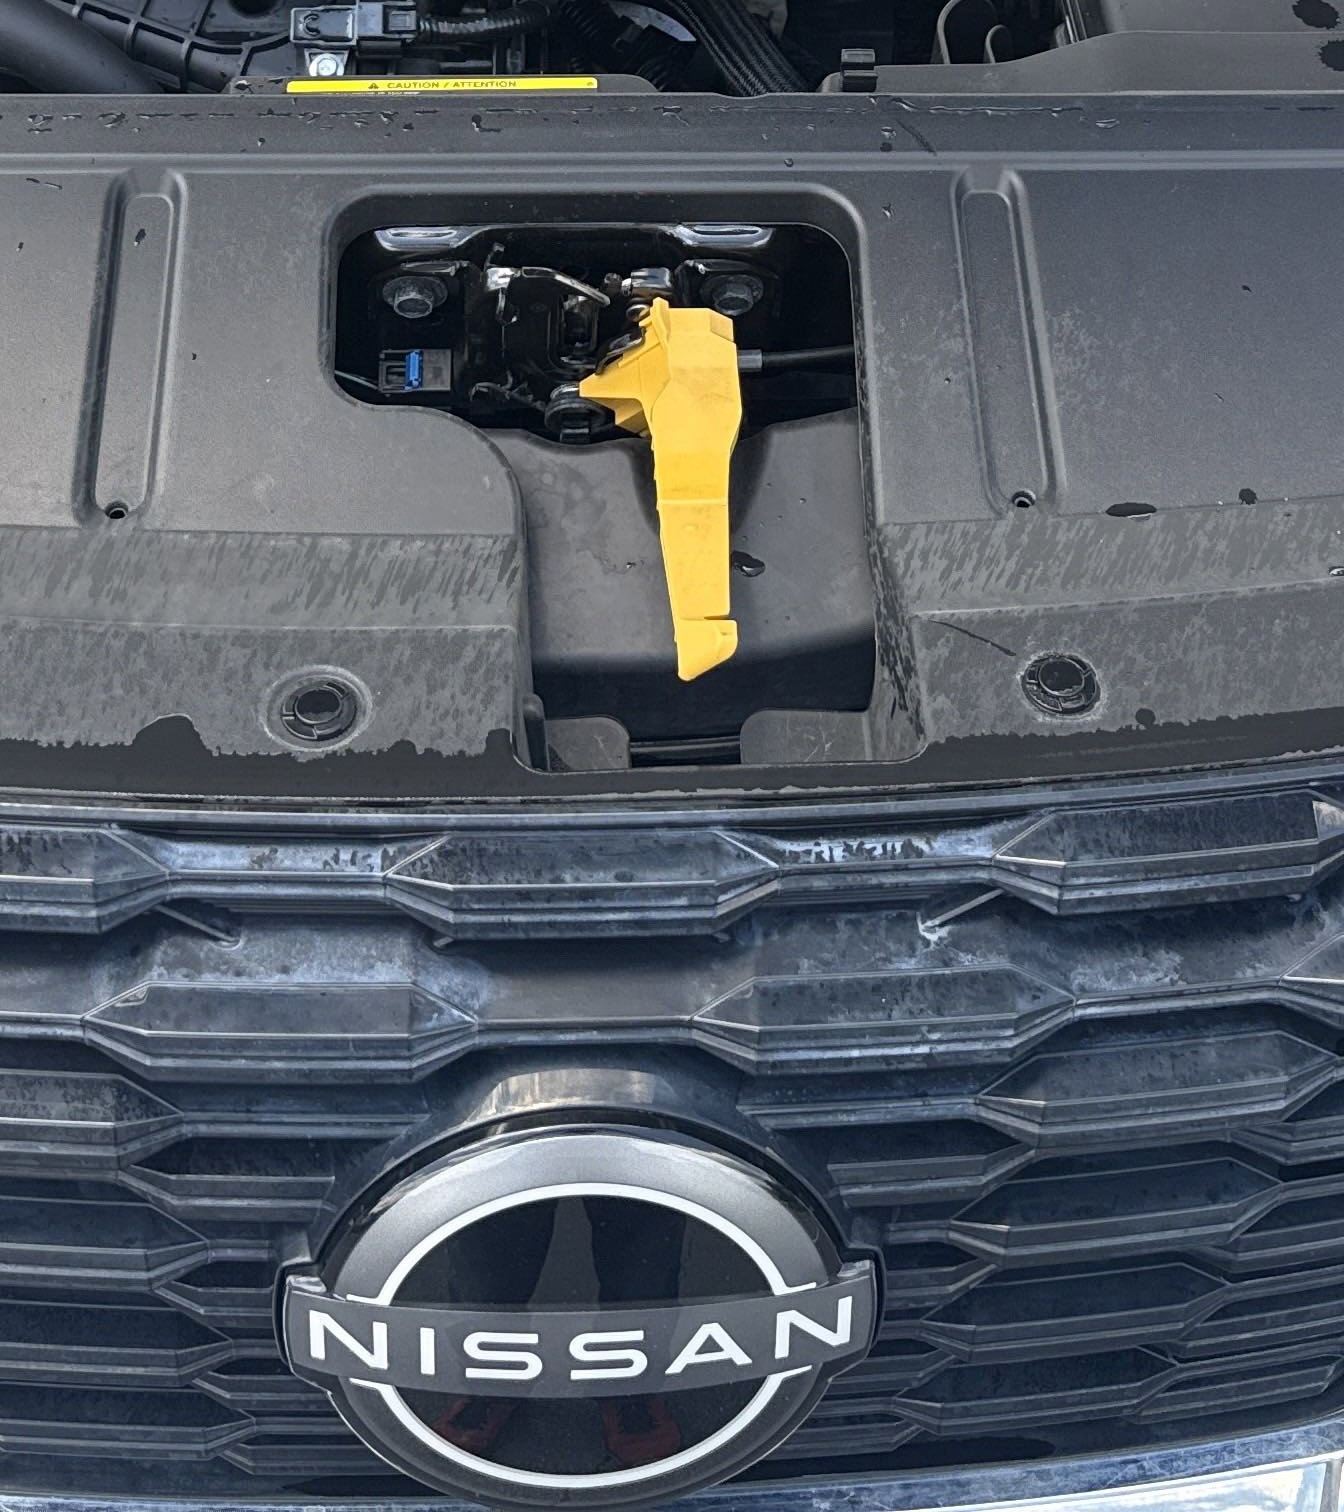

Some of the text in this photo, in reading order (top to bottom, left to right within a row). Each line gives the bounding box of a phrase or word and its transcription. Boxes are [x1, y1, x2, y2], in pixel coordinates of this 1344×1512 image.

[386, 81, 439, 89] CAUTION
[452, 80, 517, 88] ATTENTION
[308, 1294, 854, 1382] NISSAN
